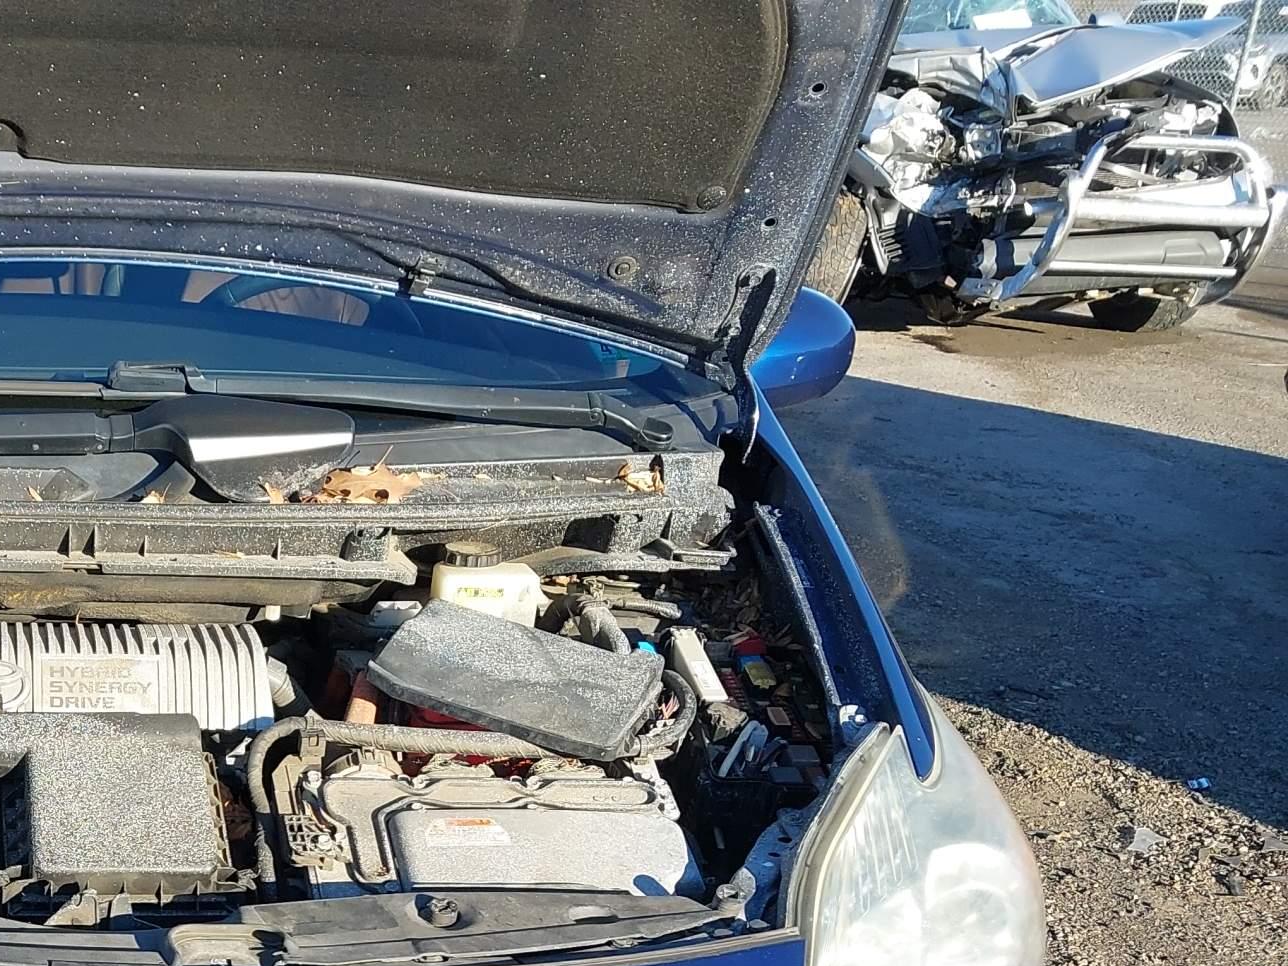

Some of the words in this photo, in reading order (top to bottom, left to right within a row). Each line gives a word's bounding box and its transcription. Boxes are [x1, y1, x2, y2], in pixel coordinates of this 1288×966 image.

[49, 665, 133, 679] HYBRID
[49, 680, 152, 695] SYNERGY
[49, 695, 116, 709] DRIVE
